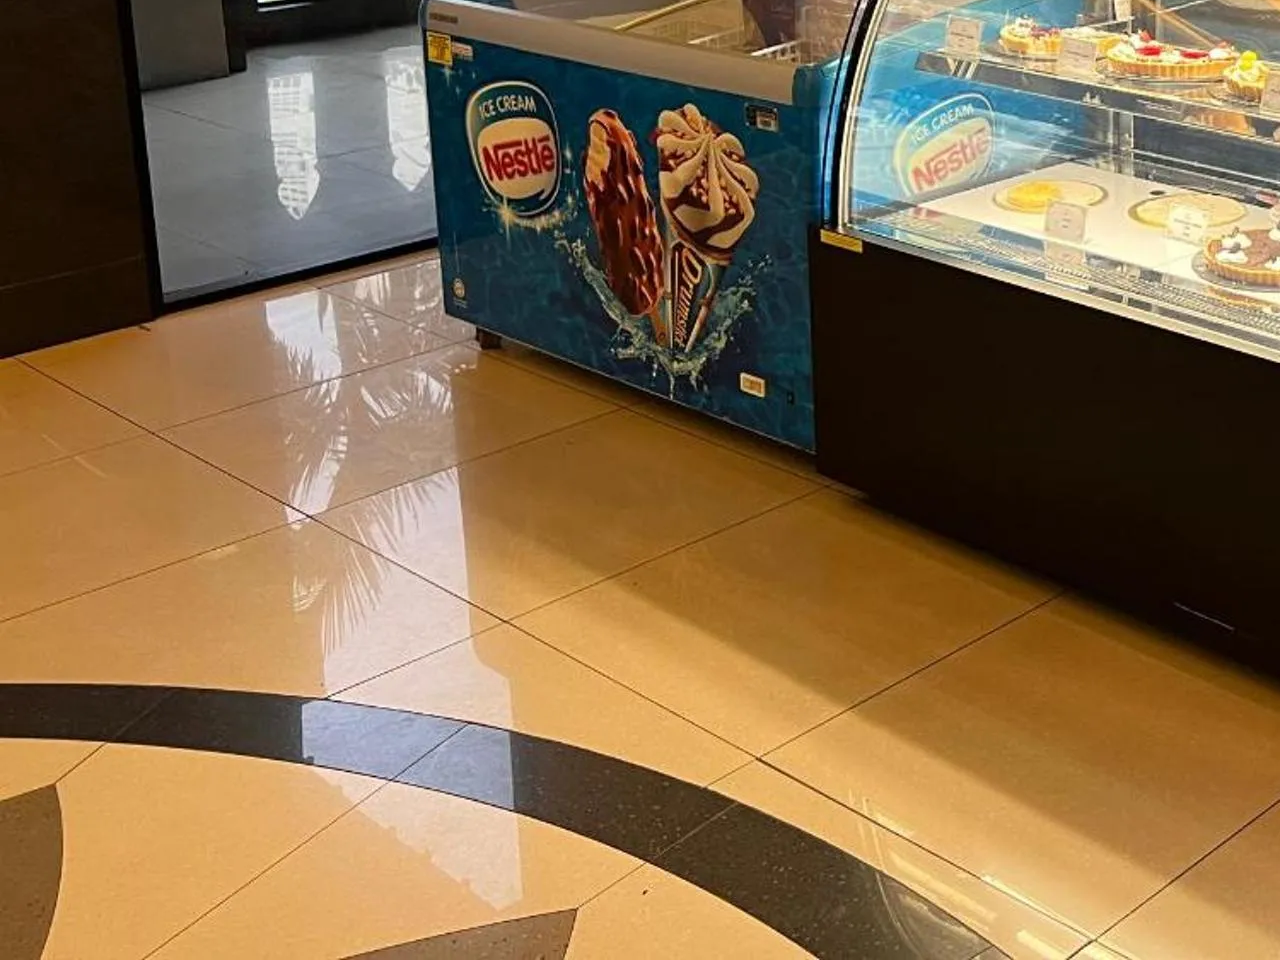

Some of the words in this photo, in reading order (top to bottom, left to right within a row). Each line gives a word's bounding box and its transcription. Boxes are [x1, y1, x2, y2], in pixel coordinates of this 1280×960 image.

[479, 100, 496, 120] ICE
[496, 94, 537, 113] CREAM
[931, 103, 975, 132] CREAM
